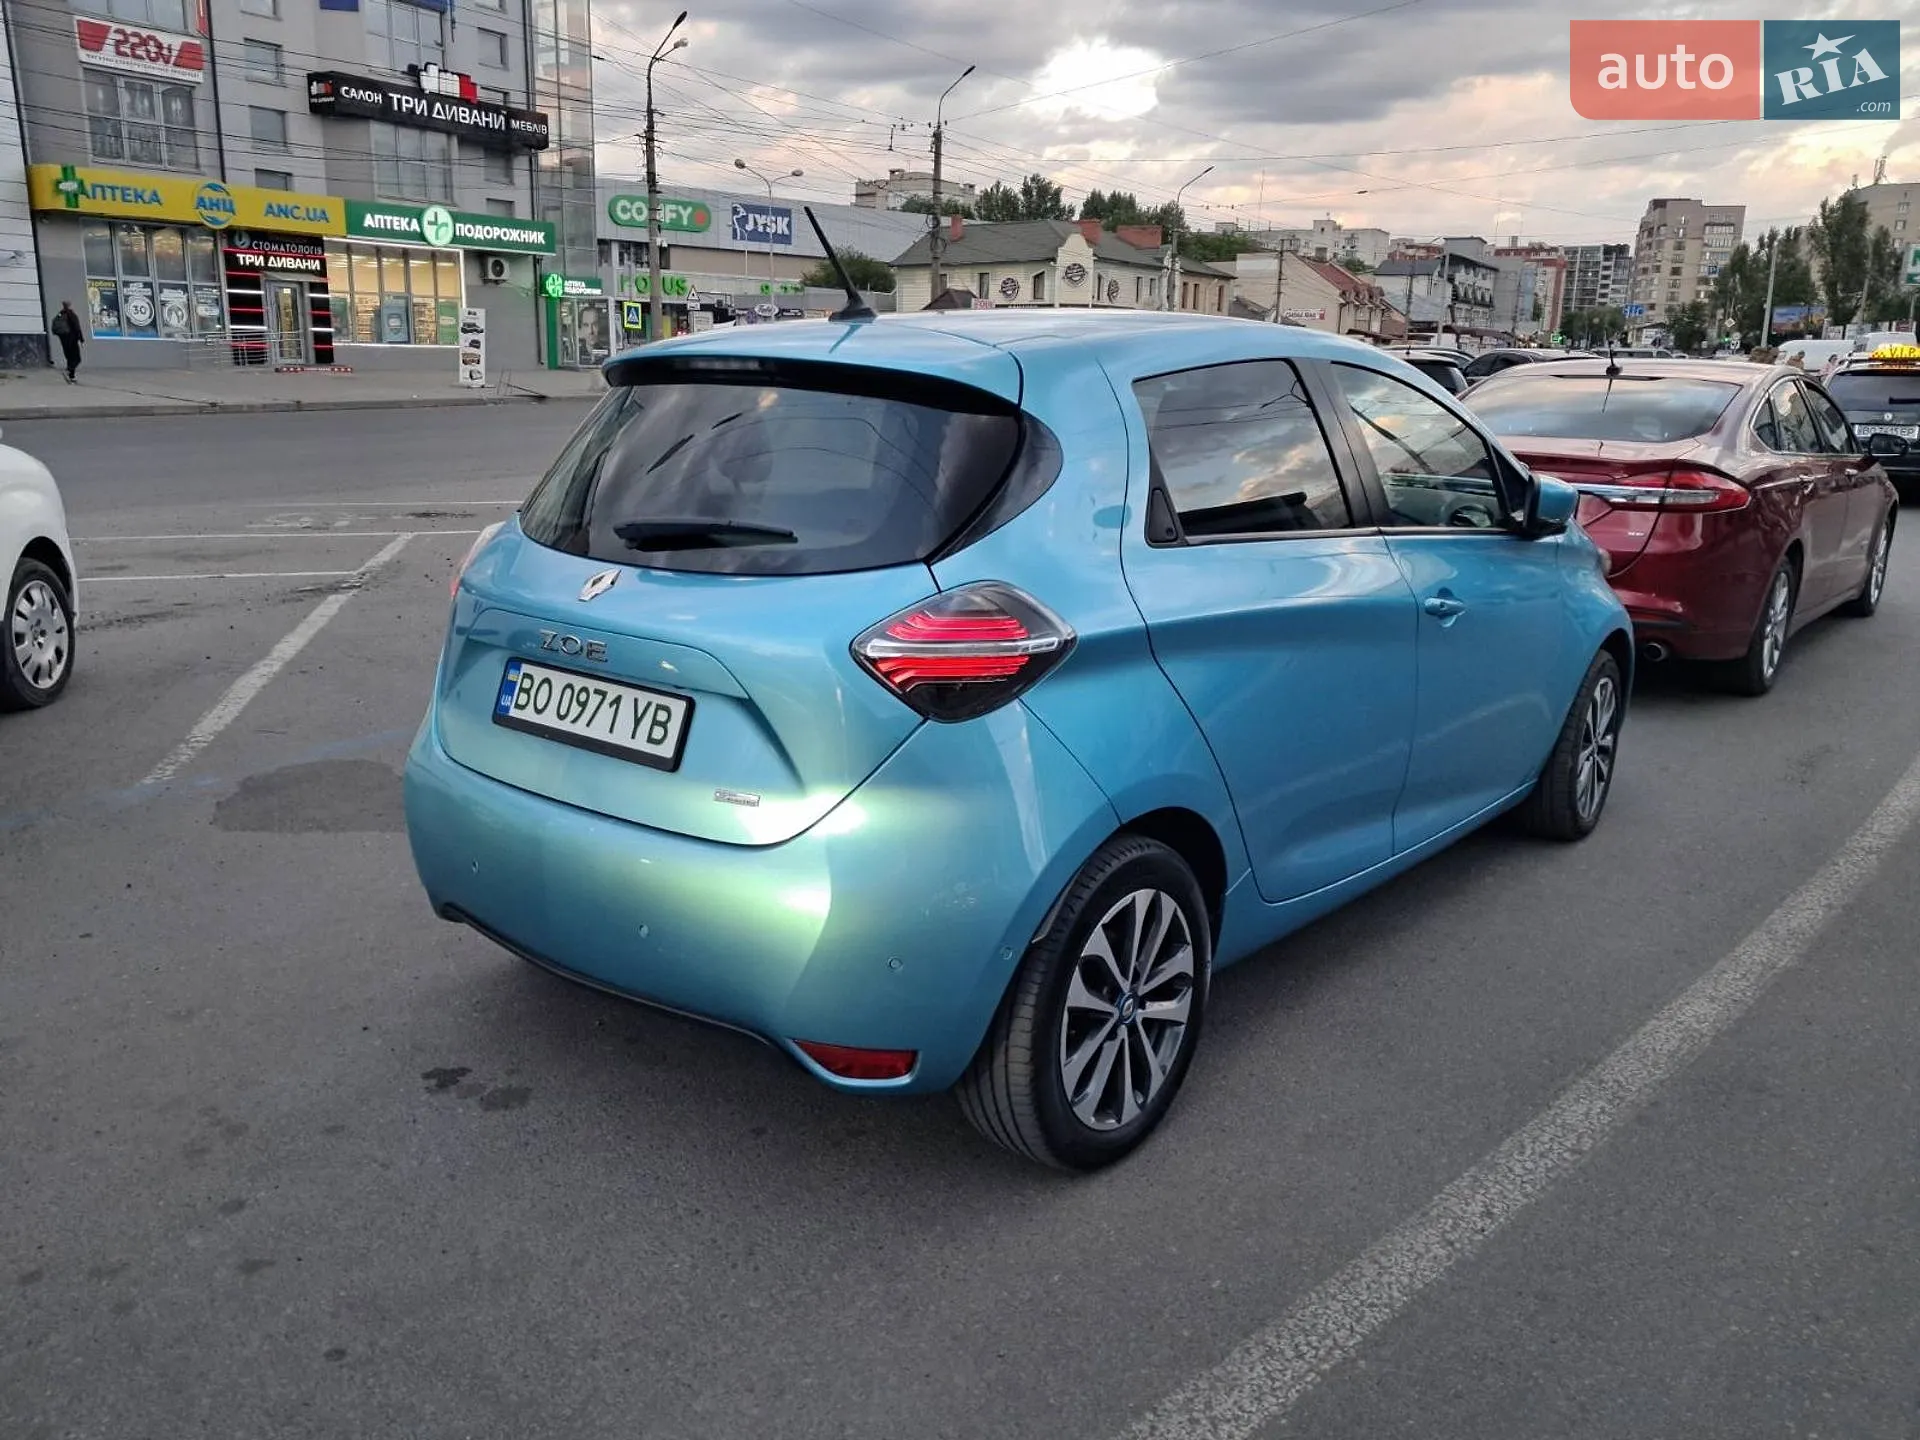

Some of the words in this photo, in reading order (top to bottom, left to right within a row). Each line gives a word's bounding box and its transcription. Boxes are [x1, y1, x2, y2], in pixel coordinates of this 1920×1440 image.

[341, 86, 382, 104] САЛОН
[388, 92, 428, 117] ТРИ
[431, 102, 506, 131] ДИВАНИ
[511, 118, 548, 135] МЕБЛІВ
[195, 195, 236, 216] АНЦ
[264, 202, 330, 223] ANC.UA
[363, 213, 421, 233] АПТЕКА
[455, 222, 546, 245] ПОДОРОЖНИК
[746, 213, 790, 236] JYSK
[236, 253, 265, 267] ТРИ
[268, 255, 321, 271] ДИВАНИ
[540, 629, 609, 663] ZOE
[501, 693, 512, 707] UA
[514, 672, 552, 715] BO
[556, 682, 622, 734] 0971
[630, 697, 673, 746] YB
